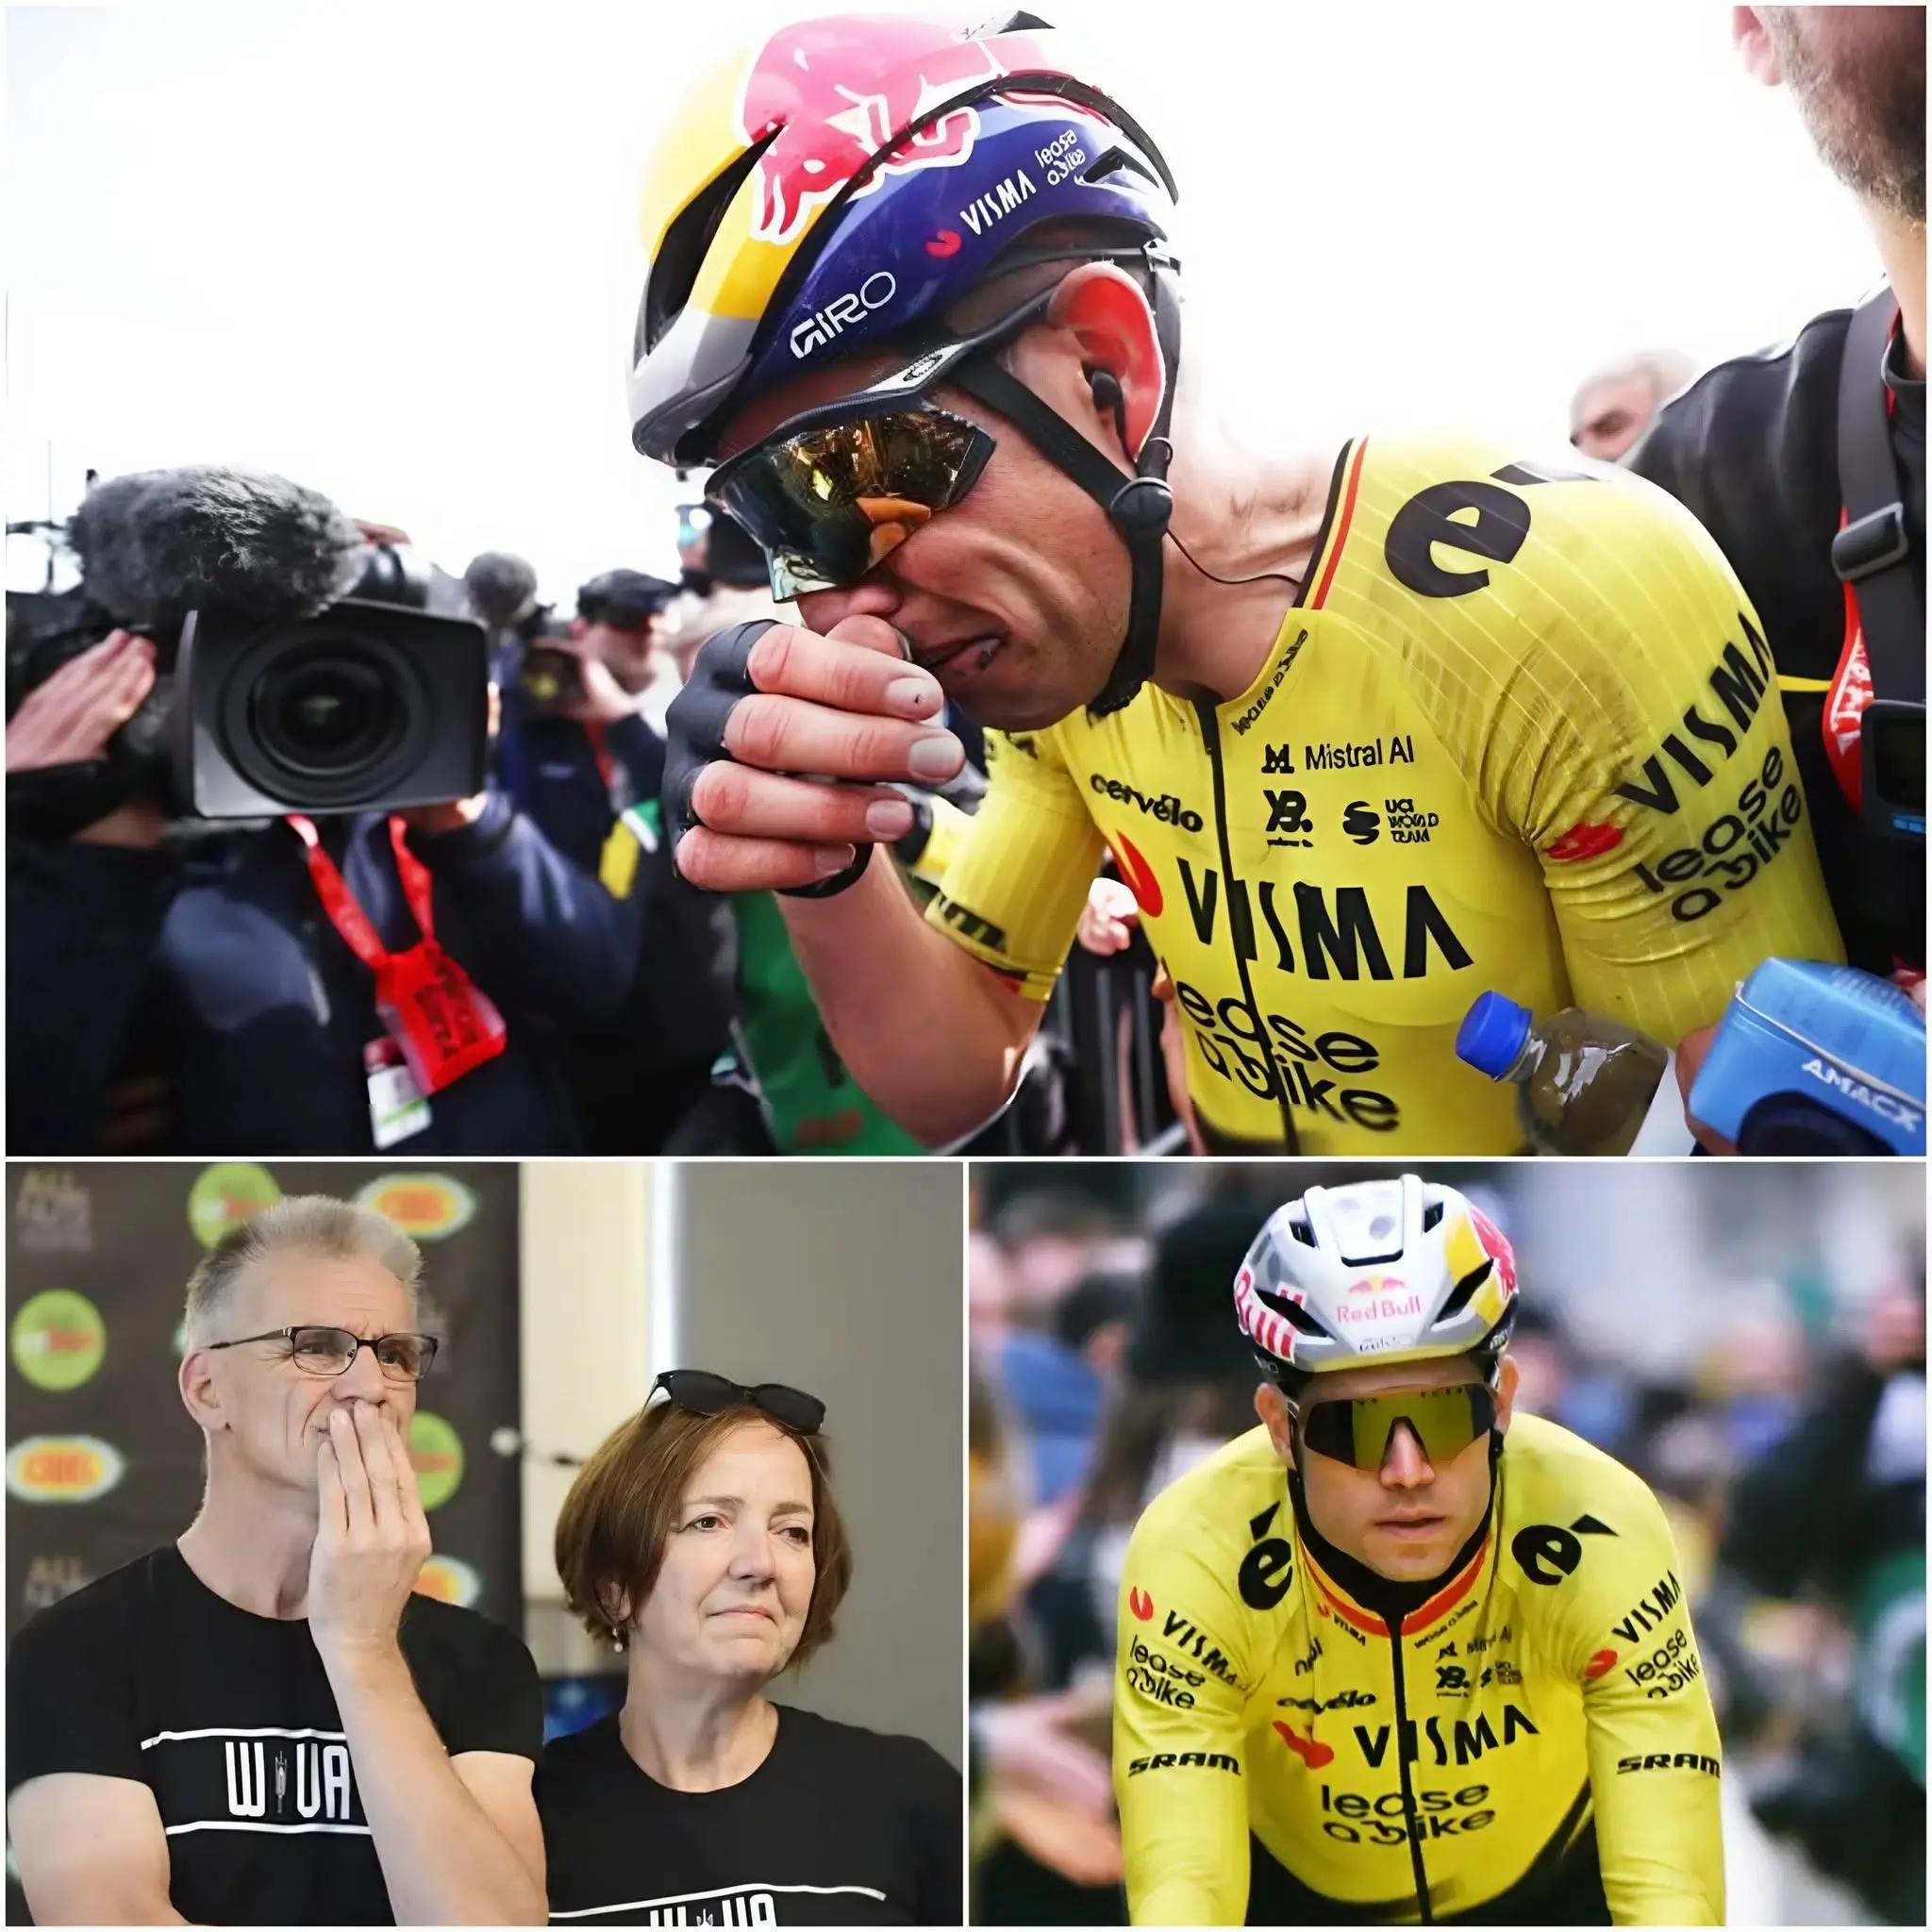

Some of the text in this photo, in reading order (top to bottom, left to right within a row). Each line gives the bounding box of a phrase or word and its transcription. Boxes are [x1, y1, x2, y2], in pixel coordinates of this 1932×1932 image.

[959, 169, 1037, 236] VISMA
[790, 272, 896, 359] GIRO
[1612, 610, 1774, 816] VISMA
[1306, 738, 1383, 771] Mistral
[1389, 734, 1415, 765] AI
[1634, 745, 1786, 893] lease
[1175, 856, 1474, 981] VISMA
[1176, 980, 1380, 1074] ease
[1381, 1295, 1421, 1319] Bull
[1610, 1569, 1681, 1643] VISMA
[1162, 1609, 1241, 1688] VISMA
[1624, 1628, 1688, 1688] lease
[1128, 1752, 1241, 1777] SRAM
[1353, 1705, 1541, 1769] VISMA
[1616, 1753, 1722, 1779] SRAM
[1322, 1784, 1491, 1819] lease
